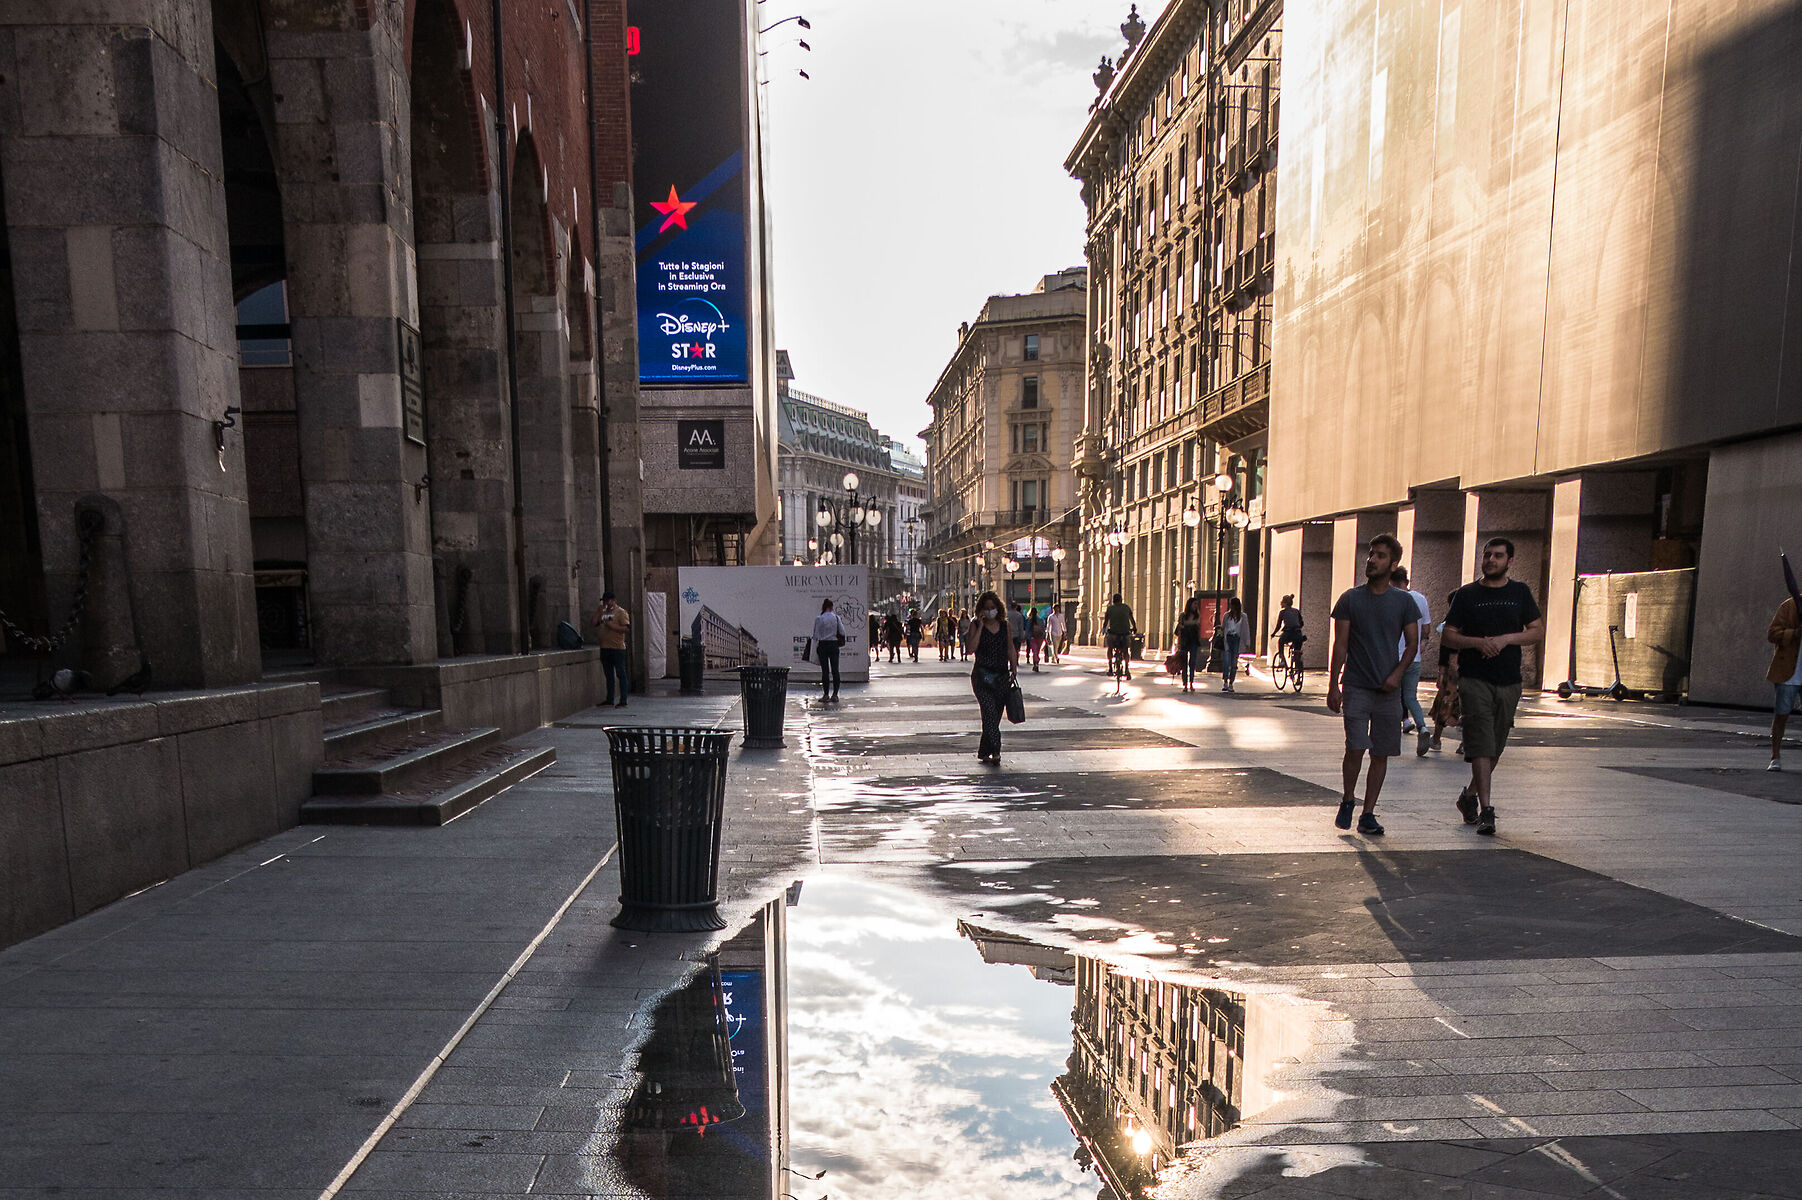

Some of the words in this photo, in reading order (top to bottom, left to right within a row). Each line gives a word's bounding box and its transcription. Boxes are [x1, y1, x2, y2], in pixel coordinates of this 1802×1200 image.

[658, 261, 680, 271] Tutte
[681, 261, 690, 271] le
[691, 261, 725, 272] Stagioni
[669, 272, 677, 281] in
[679, 272, 715, 281] Esclusiva
[658, 283, 666, 291] in
[667, 282, 709, 293] Streaming
[710, 282, 726, 291] Ora
[656, 312, 730, 341] Disney+
[671, 364, 717, 372] DisneyPlus.com
[785, 575, 844, 587] MERCANTI
